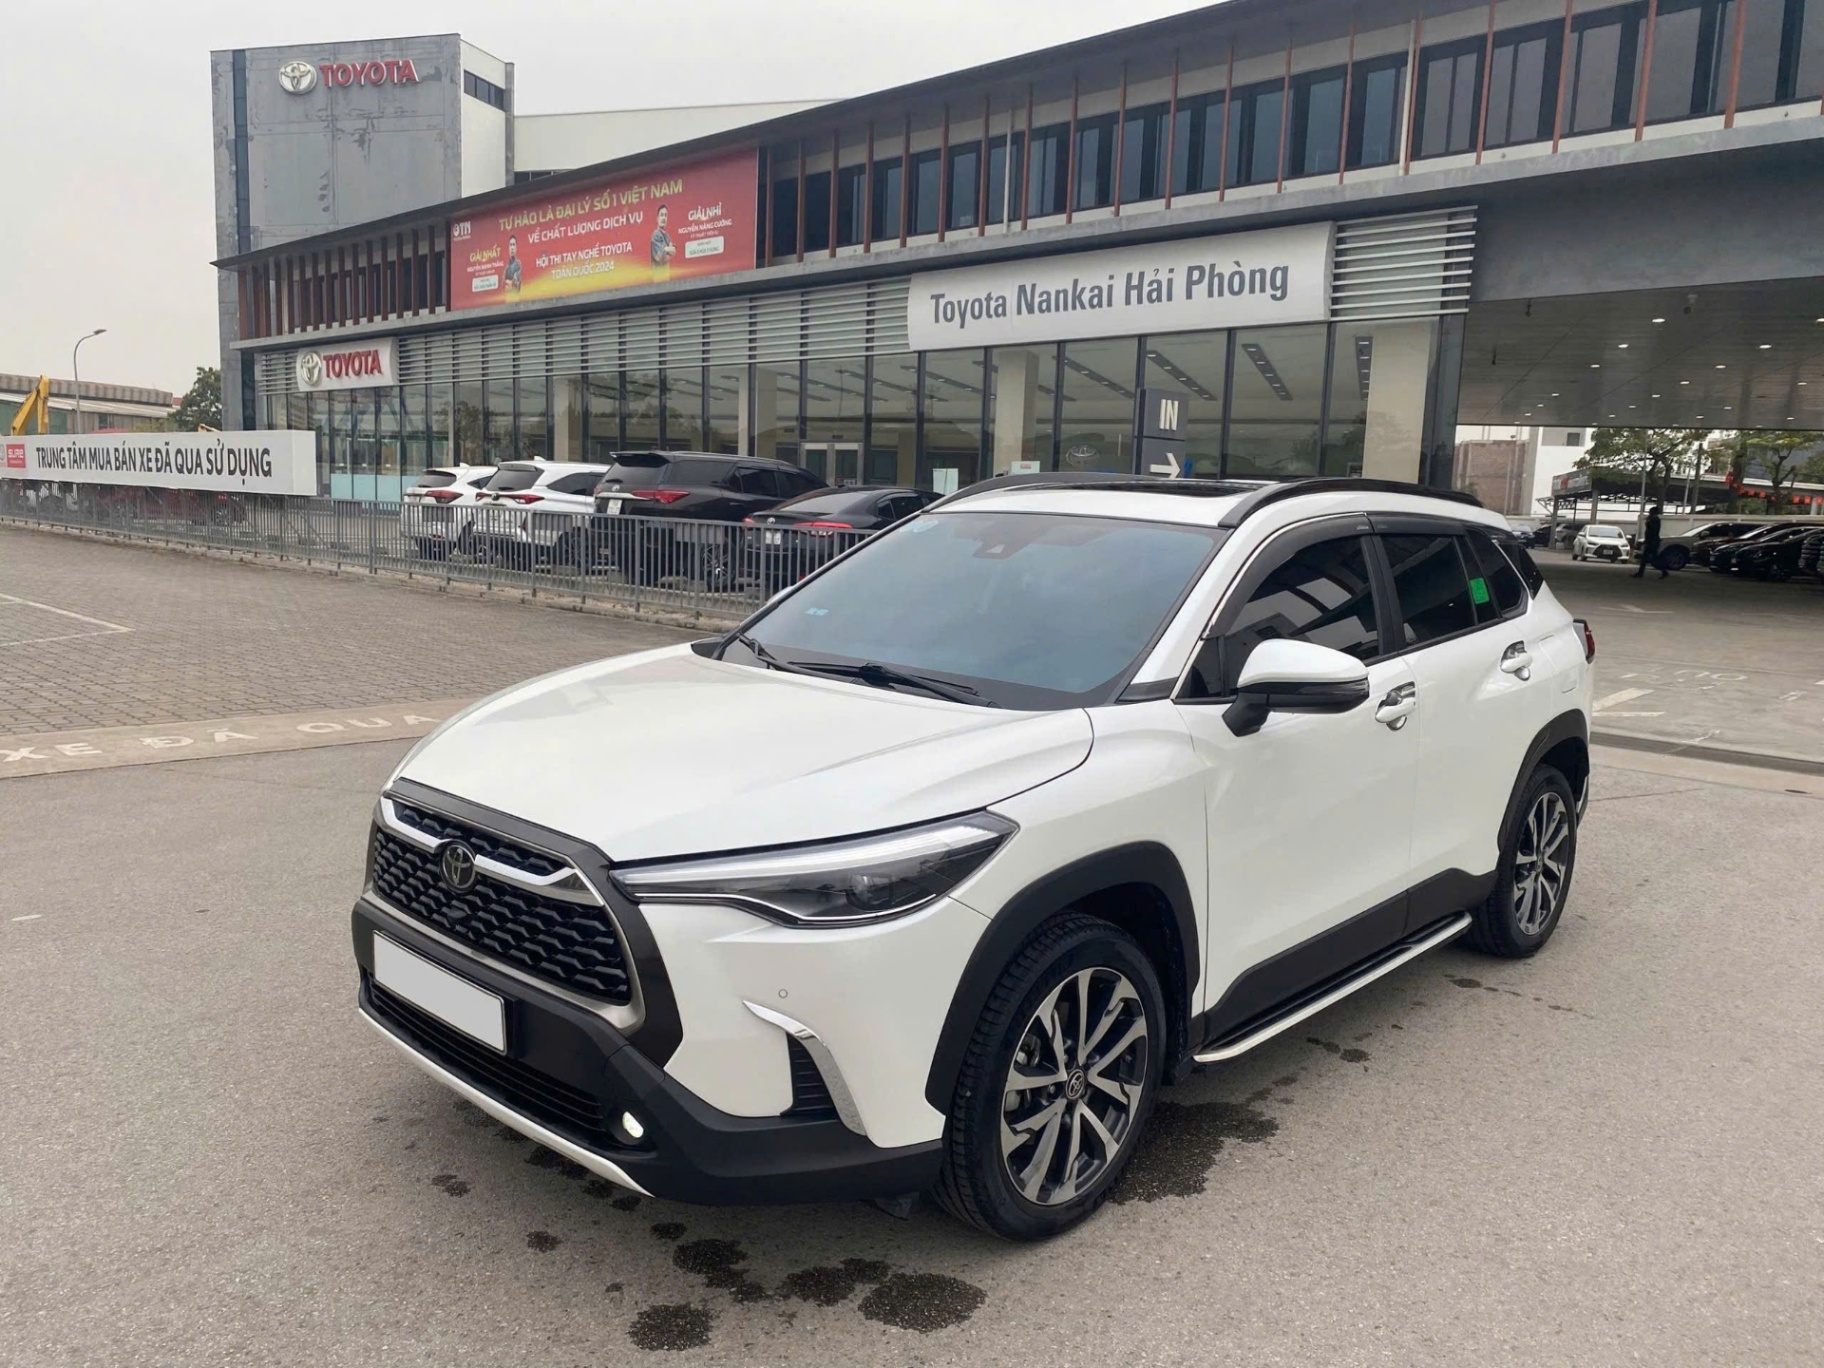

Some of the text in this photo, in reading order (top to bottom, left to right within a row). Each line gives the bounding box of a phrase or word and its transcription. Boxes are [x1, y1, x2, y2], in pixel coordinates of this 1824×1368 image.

[319, 59, 420, 89] TOYOTA
[499, 179, 683, 231] TỰ HÀO LÀ ĐẠI LÝ SỐ 1 VIỆT NAM
[528, 211, 643, 244] VỀ CHẤT LƯỢNG DỊCH VỤ
[536, 241, 632, 268] HỘI THI TAY NGHỀ TOYOTA
[551, 259, 614, 280] TOÀN QUỐC 2024
[930, 260, 1290, 329] Toyota Nankai Hải Phòng
[323, 349, 383, 379] TOYOTA
[1158, 398, 1179, 431] IN
[36, 438, 272, 485] TRUNG TÂM MUA BÁN XE ĐÃ QUA SỬ DỤNG
[0, 713, 440, 762] XE ĐÃ QUA
